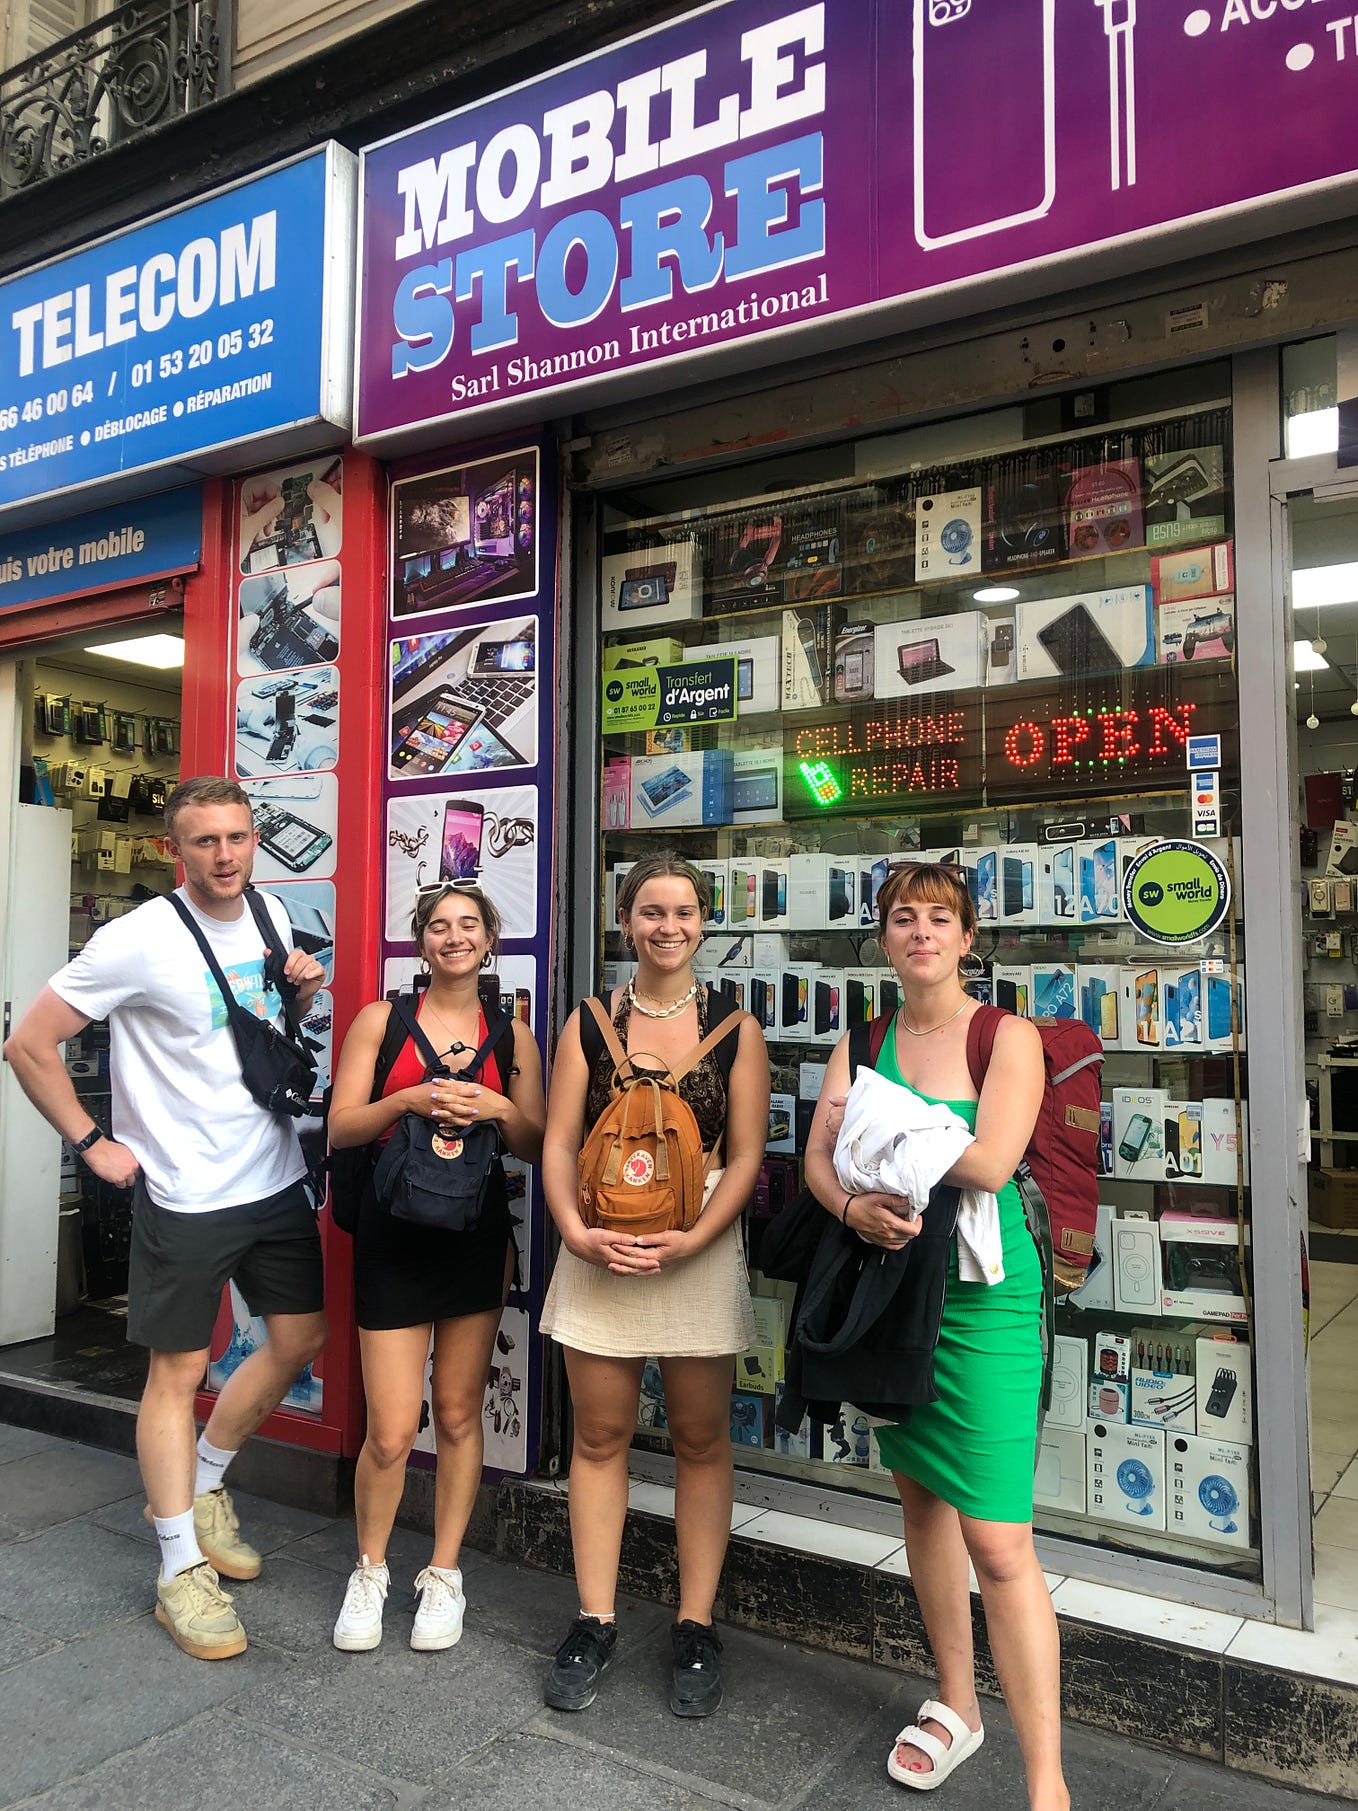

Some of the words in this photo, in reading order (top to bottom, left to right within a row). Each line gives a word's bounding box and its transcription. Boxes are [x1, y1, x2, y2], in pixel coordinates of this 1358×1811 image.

[395, 2, 826, 261] MOBILE
[392, 131, 827, 380] STORE
[12, 209, 277, 378] TELECOM
[451, 364, 499, 401] Sarl
[507, 339, 621, 388] Shannon
[629, 273, 830, 354] International
[22, 398, 42, 424] 46
[46, 389, 67, 416] 00
[72, 380, 94, 407] 64
[131, 361, 152, 388] 01
[159, 352, 184, 379] 53
[188, 343, 213, 370] 20
[217, 329, 243, 360] 05
[247, 318, 274, 348] 32
[8, 434, 74, 469] TÉLÉPHONE
[95, 404, 168, 443] DÉBLOCAGE
[186, 372, 273, 414] RÉPARATION
[791, 527, 838, 542] HEADPHONES
[27, 543, 74, 578] votre
[79, 526, 145, 565] mobile
[841, 624, 868, 635] Energizer
[626, 677, 649, 690] small
[666, 671, 712, 688] Transfert
[631, 684, 657, 696] world
[665, 683, 730, 706] d'Argent
[1004, 702, 1197, 767] OPEN
[851, 758, 960, 798] REPAIR
[1197, 809, 1216, 817] VISA
[1136, 854, 1149, 868] Envoi
[1126, 869, 1137, 890] Transfer
[1166, 877, 1201, 892] small
[1175, 885, 1213, 901] world
[1055, 982, 1075, 1003] A72
[1121, 1095, 1153, 1104] IDEOS
[1210, 1132, 1238, 1152] Y5
[1186, 1229, 1226, 1237] XSSIVE
[1202, 1310, 1231, 1318] GAMEPAD
[739, 1380, 765, 1391] Earbuds
